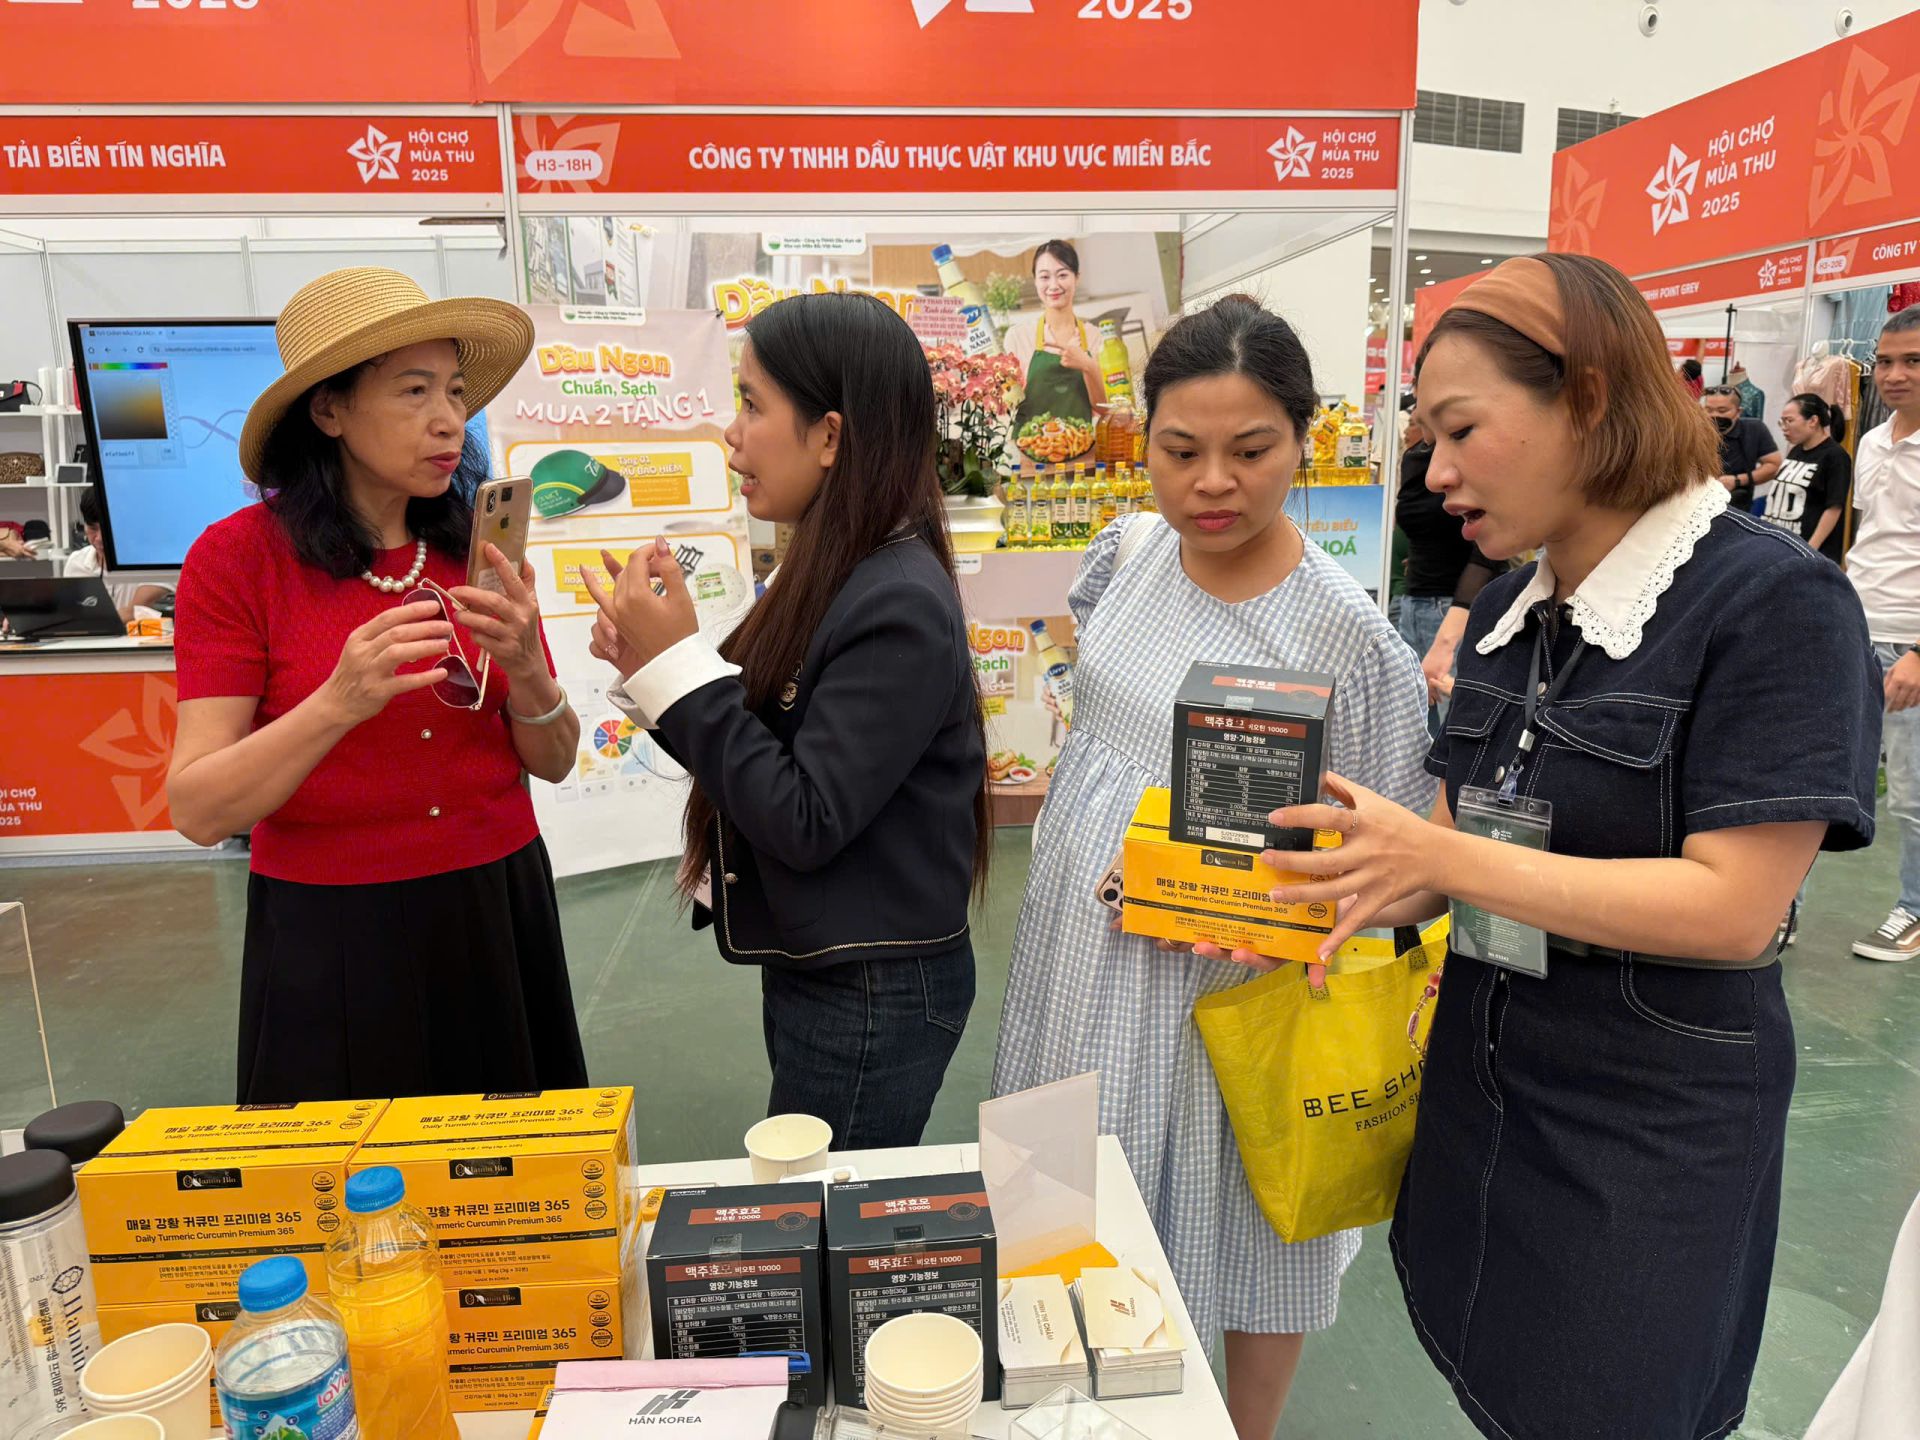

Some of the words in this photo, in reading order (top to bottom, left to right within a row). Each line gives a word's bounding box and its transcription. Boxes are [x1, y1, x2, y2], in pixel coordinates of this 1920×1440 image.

[408, 128, 434, 147] HỘI
[437, 129, 470, 147] CHỢ
[1322, 129, 1346, 146] HỘI
[1348, 130, 1376, 145] CHỢ
[1707, 128, 1735, 160] HỘI
[1738, 115, 1776, 147] CHỢ
[3, 140, 41, 168] TẢI
[47, 136, 100, 168] BIỂN
[151, 141, 226, 167] NGHĨA
[410, 146, 443, 162] MÙA
[446, 150, 475, 162] THU
[688, 142, 751, 170] CÔNG
[757, 147, 785, 169] TY
[789, 146, 849, 169] TNHH
[855, 139, 900, 169] DẦU
[905, 143, 962, 171] THỰC
[967, 141, 1007, 171] VẬT
[1013, 145, 1057, 168] KHU
[1063, 143, 1107, 170] VỰC
[1113, 138, 1163, 167] MIỀN
[1170, 138, 1212, 166] BẮC
[1322, 146, 1350, 161] MÙA
[1355, 149, 1380, 161] THU
[536, 158, 592, 172] H3-18H
[1704, 158, 1738, 188] MÙA
[1742, 149, 1777, 174] THU
[412, 169, 448, 181] 2025
[1321, 168, 1354, 179] 2025
[1701, 192, 1740, 218] 2025
[1872, 243, 1902, 260] CÔNG
[1904, 240, 1918, 255] TY
[1660, 284, 1681, 299] POINT
[537, 344, 595, 376] Dầu
[598, 343, 673, 378] Ngon
[562, 378, 617, 396] Chuẩn,
[621, 380, 657, 398] Sạch
[516, 399, 590, 426] MUA
[595, 404, 612, 427] 2
[617, 392, 693, 430] TẶNG
[697, 387, 715, 417] 1
[1267, 725, 1289, 734] 10000
[10, 786, 37, 800] CHỢ
[18, 800, 43, 812] THU
[0, 816, 22, 826] 025
[1156, 877, 1176, 889] 매일
[1178, 880, 1198, 892] 강황
[1200, 883, 1229, 897] 커큐민
[1232, 888, 1271, 902] 프리미엄
[1161, 889, 1178, 899] Daily
[1178, 892, 1208, 903] Turmeric
[1208, 896, 1242, 908] Curcumin
[1242, 902, 1273, 913] Premium
[1273, 905, 1288, 914] 365
[420, 1115, 444, 1123] 매일
[511, 1108, 556, 1118] 프리미엄
[558, 1107, 585, 1115] 365
[480, 1119, 519, 1127] Curcumin
[1355, 1101, 1407, 1132] FASHION
[165, 1126, 191, 1134] 매일
[257, 1120, 305, 1129] 프리미엄
[306, 1119, 333, 1127] 365
[223, 1129, 263, 1137] Curcumin
[427, 1206, 451, 1218] 강황
[454, 1203, 490, 1216] 커큐민
[493, 1201, 541, 1214] 프리미엄
[544, 1199, 570, 1211] 365
[126, 1217, 152, 1231] 매일
[154, 1217, 180, 1231] 강황
[183, 1215, 220, 1229] 커큐민
[223, 1213, 272, 1226] 프리미엄
[275, 1211, 302, 1223] 365
[436, 1221, 465, 1230] rmeric
[466, 1218, 507, 1229] Curcumin
[507, 1216, 544, 1226] Premium
[546, 1214, 562, 1223] 365
[135, 1233, 157, 1244] Daily
[157, 1232, 196, 1243] Turmeric
[196, 1230, 238, 1240] Curcumin
[238, 1228, 276, 1238] Premium
[277, 1226, 295, 1236] 365
[916, 1256, 937, 1266] 비오틴
[939, 1255, 962, 1264] 10000
[685, 1263, 733, 1279] 맥주효모
[734, 1265, 756, 1274] 비오틴
[758, 1264, 781, 1272] 10000
[891, 1271, 940, 1284] 영양·기능정보
[708, 1279, 759, 1291] 영양·기능정보
[464, 1330, 499, 1343] 커큐민
[502, 1328, 549, 1341] 프리미엄
[552, 1327, 577, 1338] 365
[476, 1345, 515, 1354] Curcumin
[516, 1344, 552, 1352] Premium
[553, 1342, 569, 1350] 365
[56, 1398, 67, 1413] 365
[658, 1415, 702, 1424] KOREA
